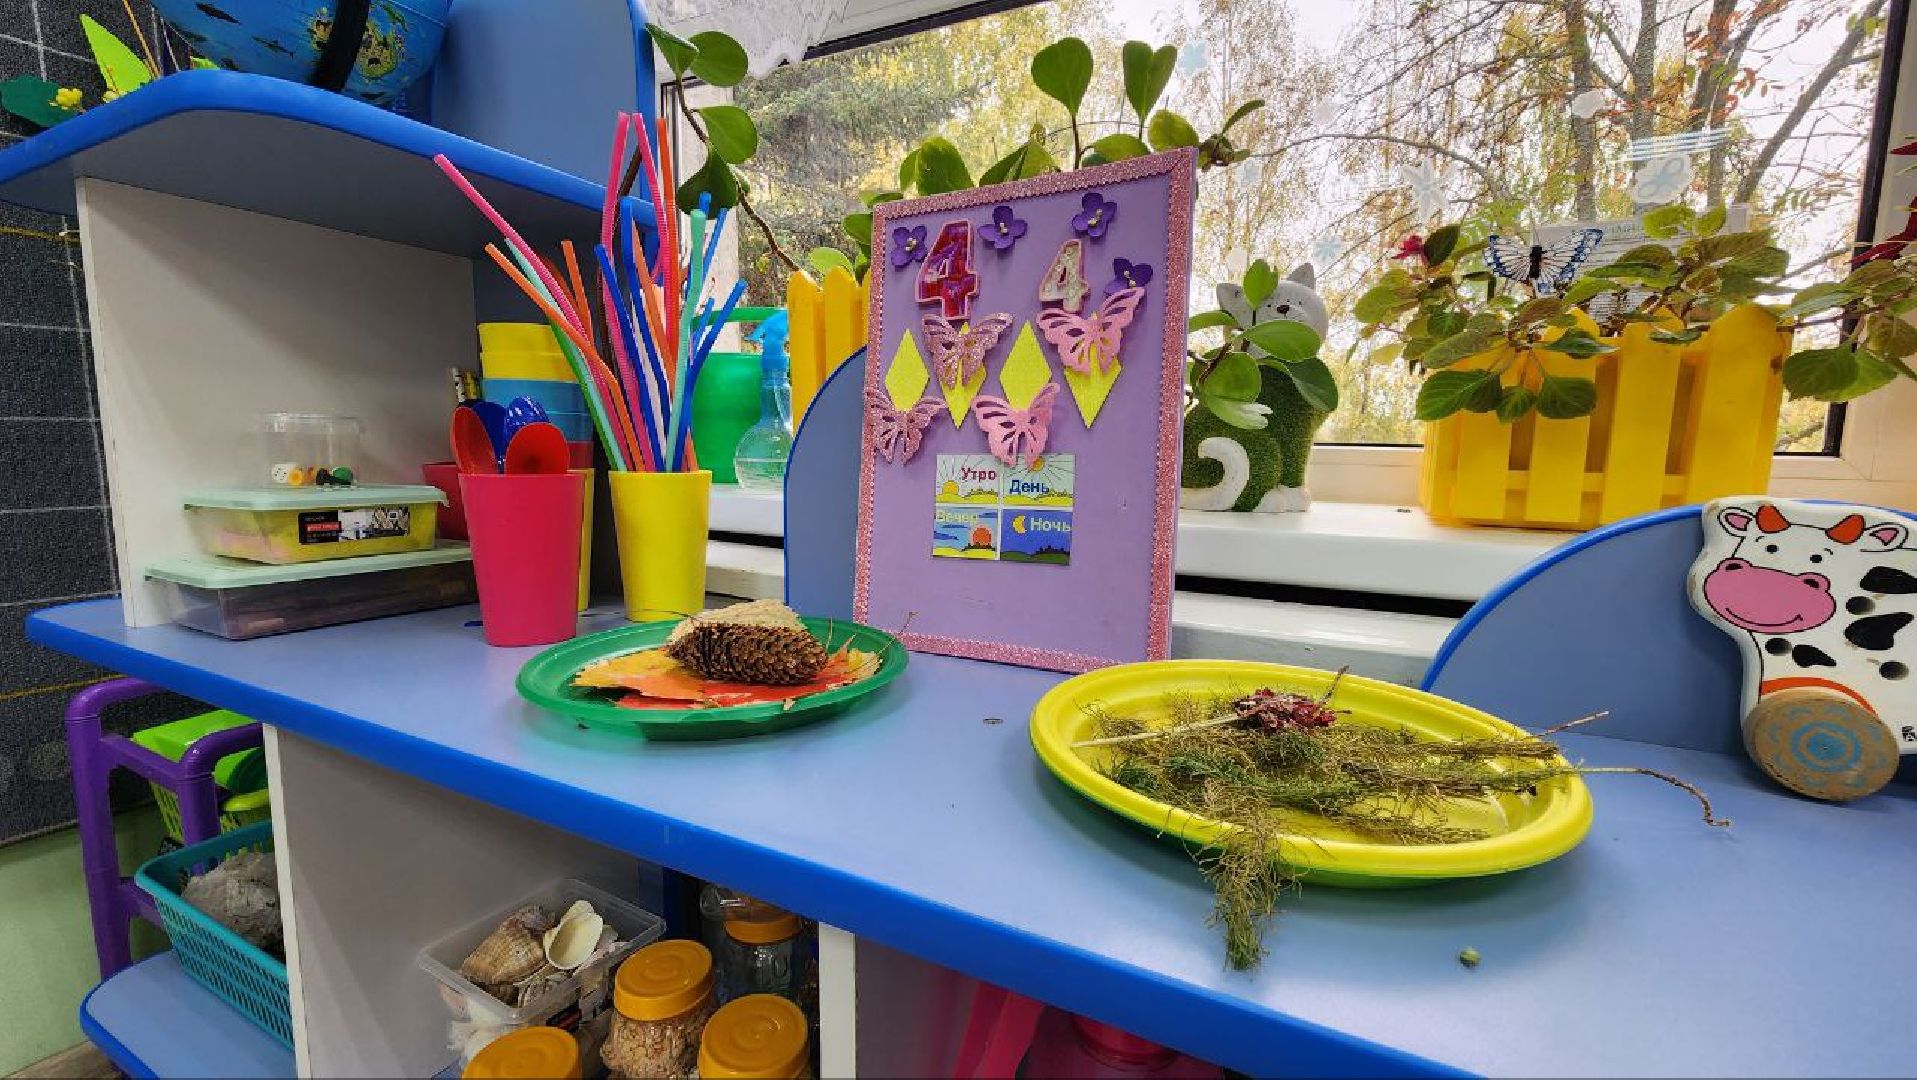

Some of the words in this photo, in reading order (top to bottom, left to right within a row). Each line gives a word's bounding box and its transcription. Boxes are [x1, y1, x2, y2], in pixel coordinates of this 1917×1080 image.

[915, 219, 979, 320] 4
[1039, 238, 1089, 313] 4
[961, 467, 998, 482] Утро
[1009, 479, 1050, 495] День
[1030, 517, 1072, 532] Ночь
